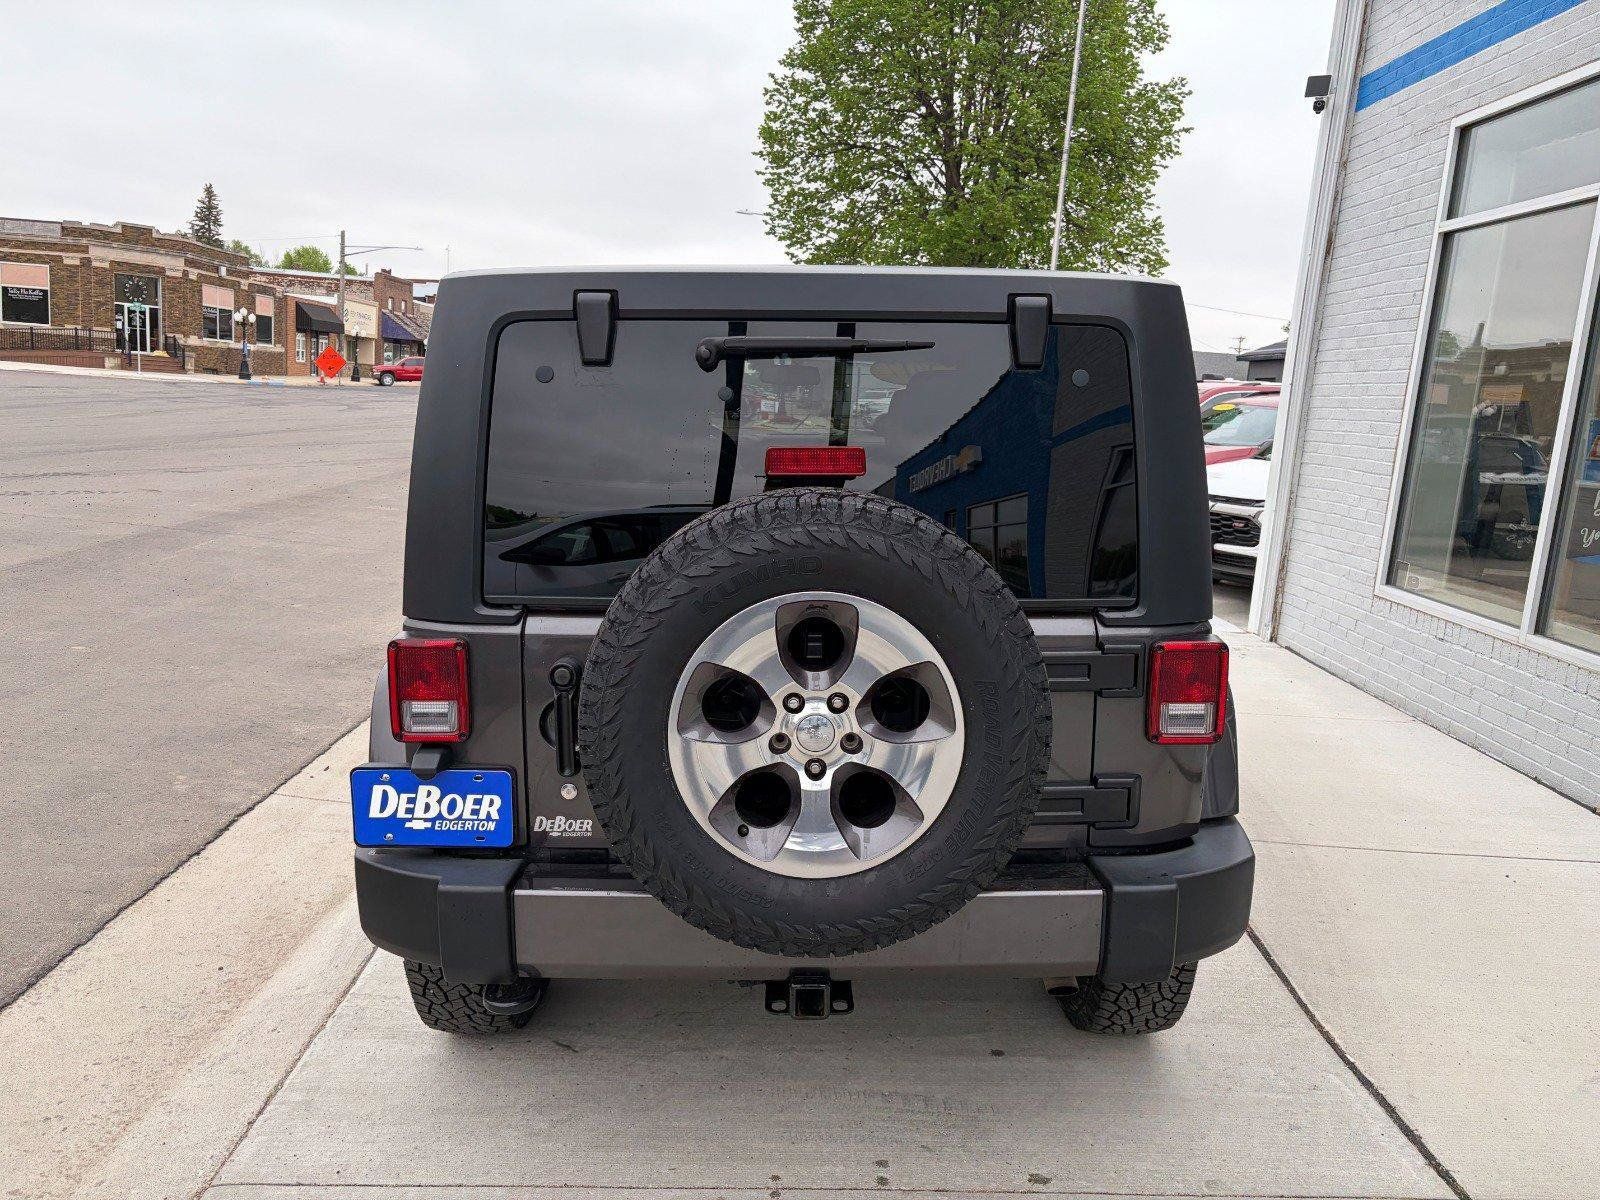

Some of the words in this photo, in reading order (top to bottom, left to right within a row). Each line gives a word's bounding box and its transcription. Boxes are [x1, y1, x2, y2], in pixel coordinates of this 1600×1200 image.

[688, 554, 824, 616] KUMHO
[368, 784, 502, 820] DEBOER
[434, 820, 497, 831] EDGERTON
[533, 815, 593, 832] DEBOER
